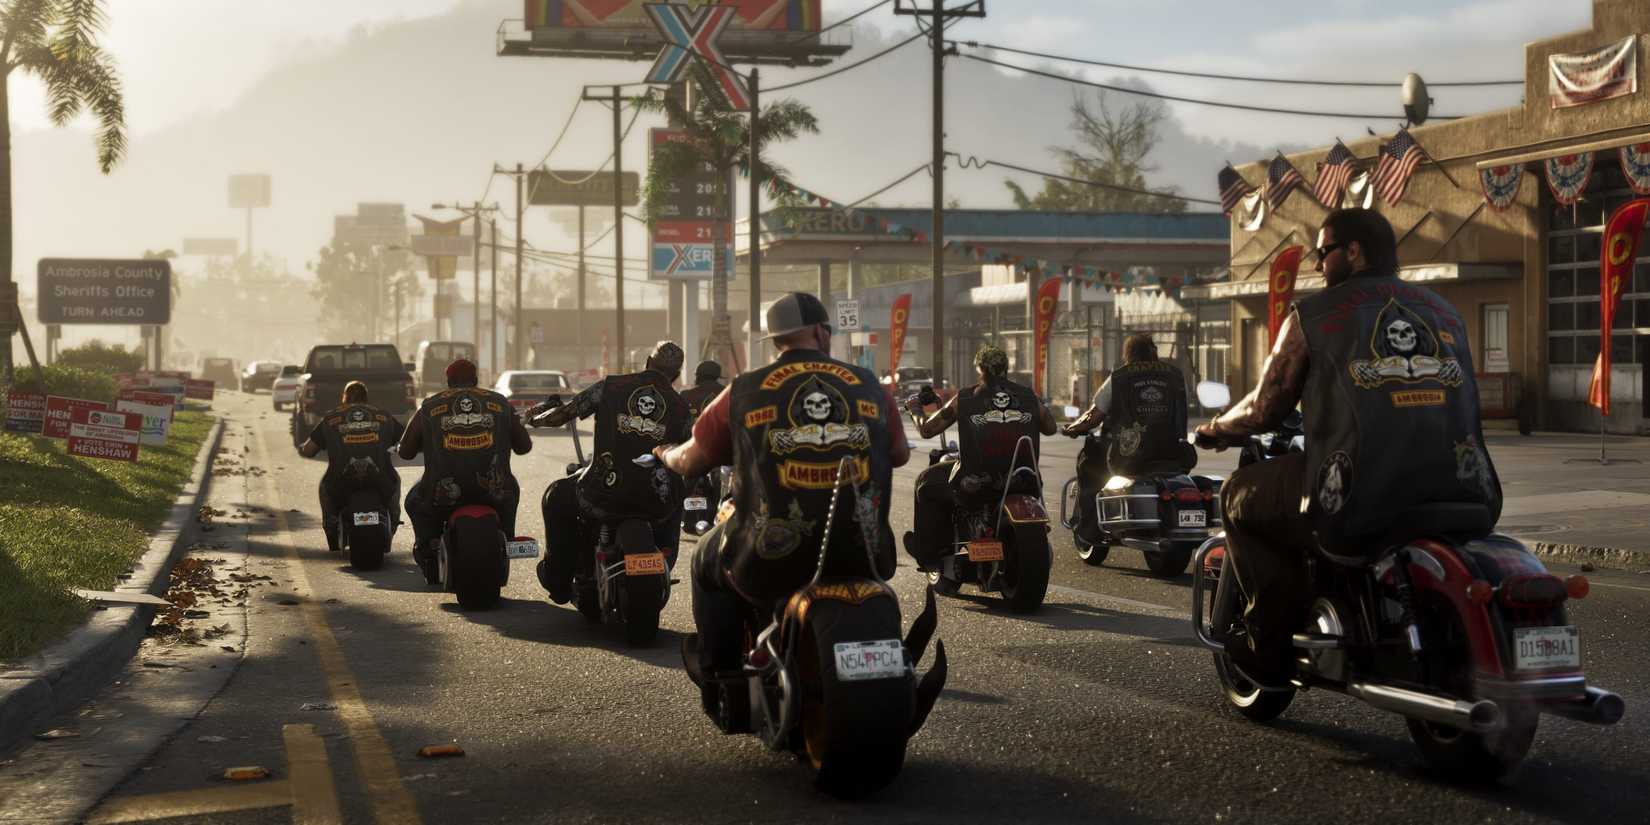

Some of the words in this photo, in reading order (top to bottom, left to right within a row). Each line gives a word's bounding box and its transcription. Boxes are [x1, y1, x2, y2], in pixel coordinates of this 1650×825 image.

[666, 243, 712, 275] XER
[46, 265, 110, 278] Ambrosia
[115, 266, 163, 281] County
[55, 284, 110, 297] Sheriffs
[116, 285, 155, 297] Office
[62, 305, 95, 318] TURN
[101, 306, 144, 318] AHEAD
[840, 315, 857, 327] 35
[765, 366, 800, 389] FINAL
[803, 363, 856, 384] CHAPTER
[73, 444, 132, 459] HENSHAW
[788, 463, 860, 484] AMBROA
